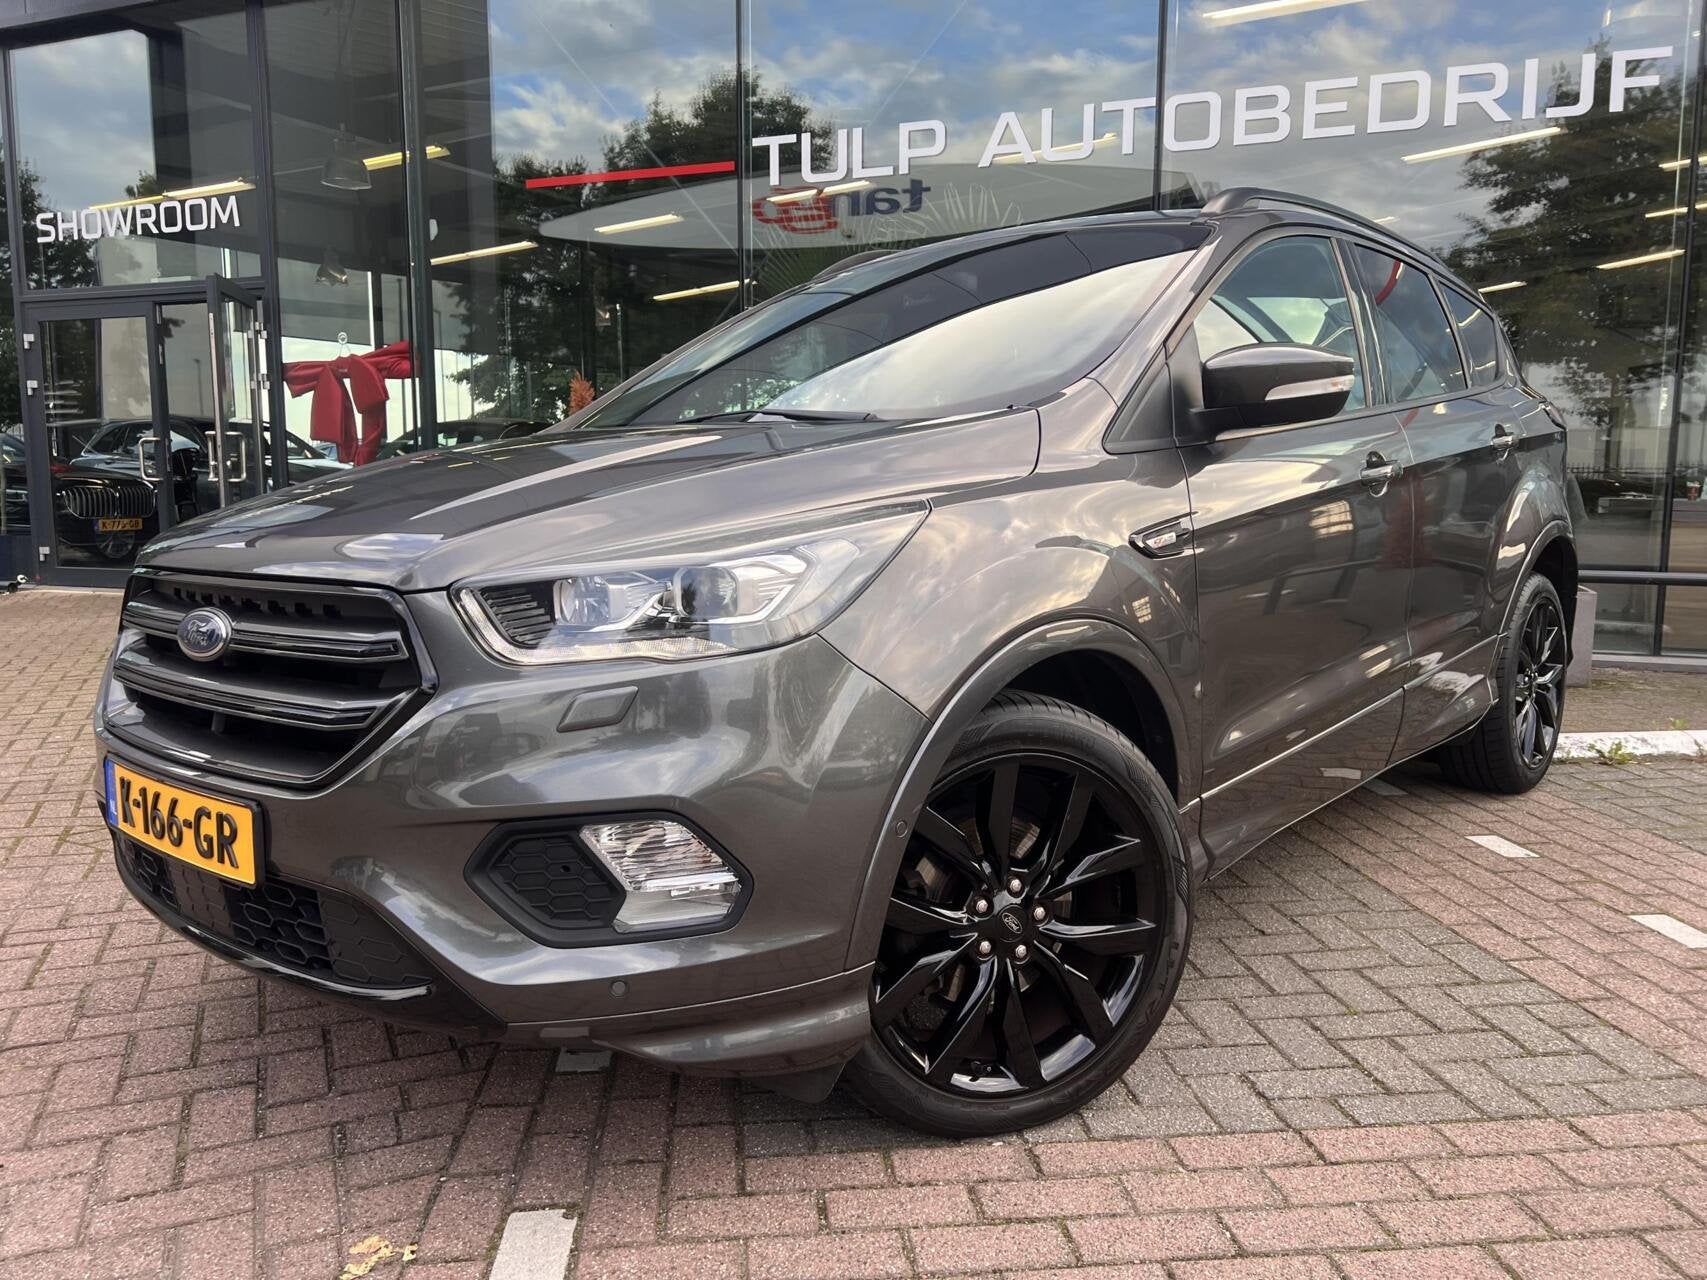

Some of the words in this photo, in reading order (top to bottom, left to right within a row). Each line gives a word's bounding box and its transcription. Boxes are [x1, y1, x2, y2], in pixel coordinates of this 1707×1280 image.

[752, 119, 946, 186] TULP
[978, 46, 1674, 168] AUTOBEDRIJF
[35, 195, 240, 243] SHOWROOM
[119, 776, 240, 869] K-166-GR
